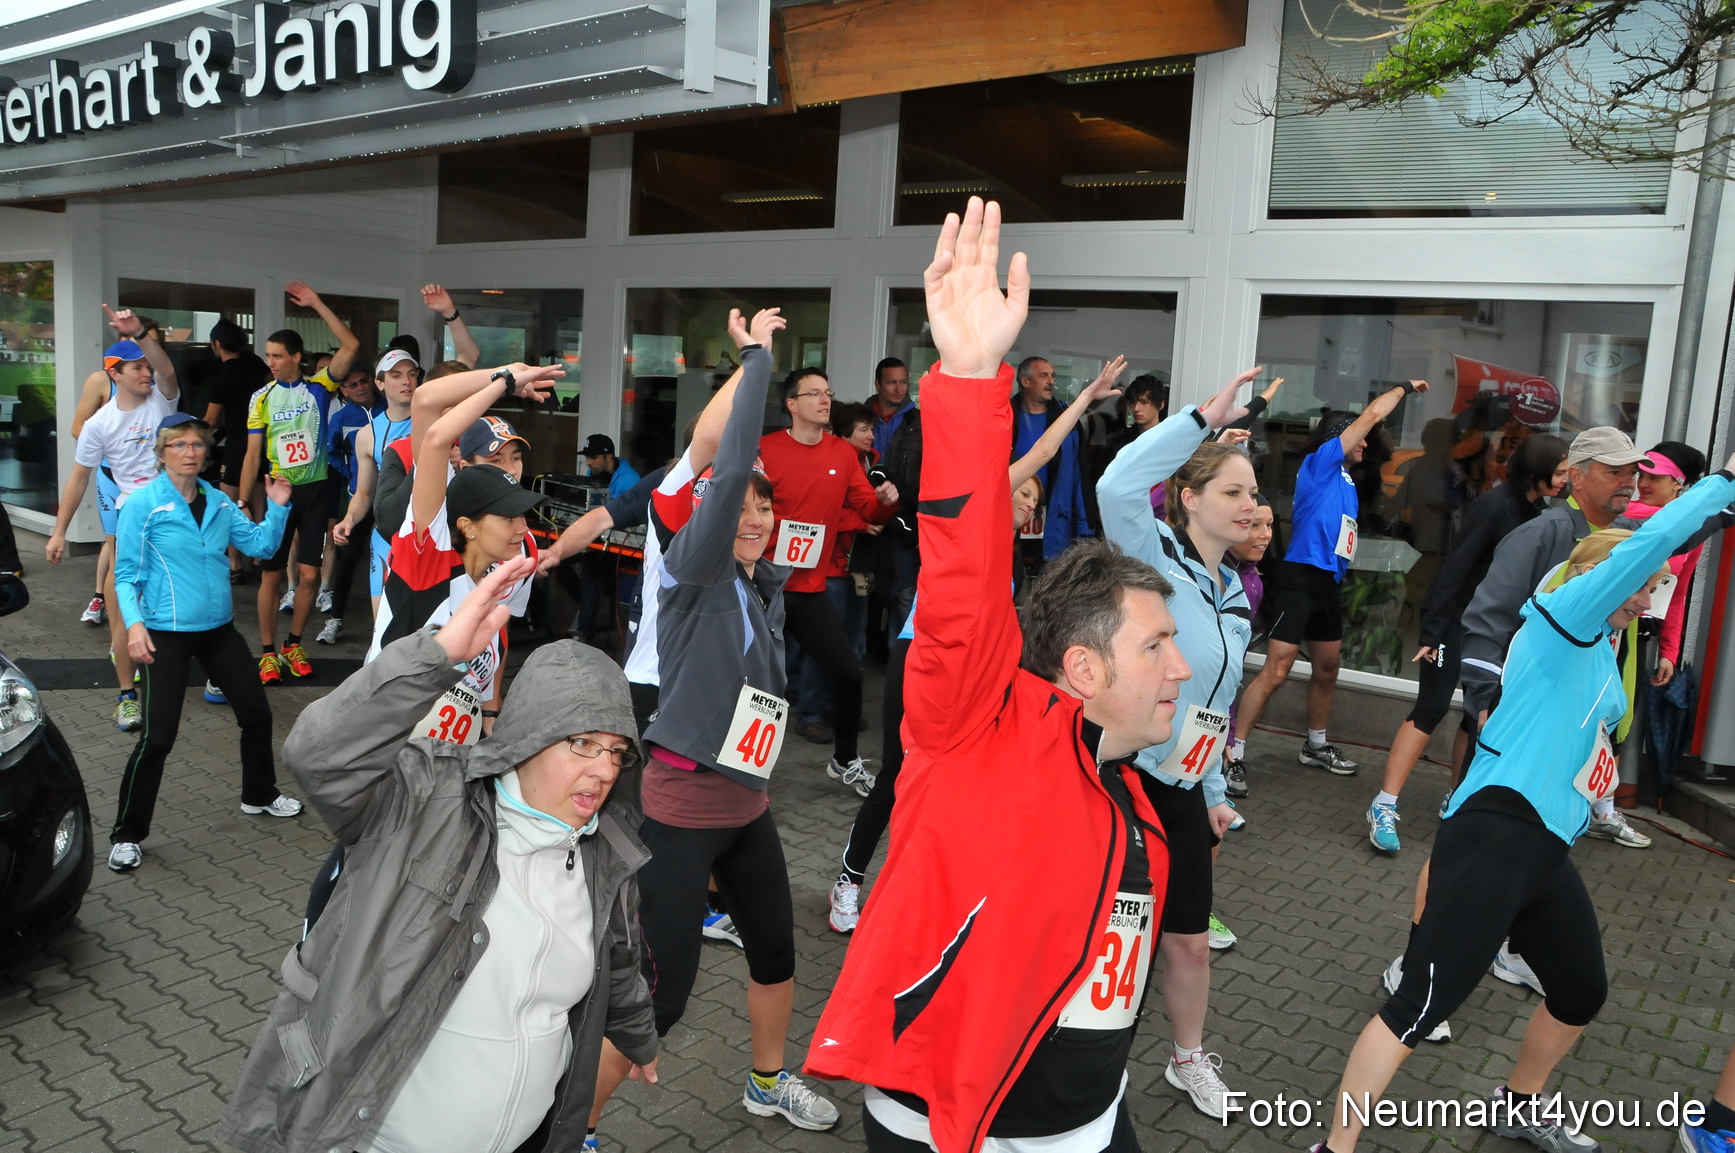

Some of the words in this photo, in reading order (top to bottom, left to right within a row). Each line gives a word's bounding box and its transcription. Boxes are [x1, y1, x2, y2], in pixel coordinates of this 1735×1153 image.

[183, 26, 222, 108] &
[285, 440, 309, 464] 23
[788, 523, 810, 531] MEYER
[786, 536, 814, 563] 67
[1346, 531, 1354, 555] 9
[468, 657, 488, 680] NIG
[444, 692, 471, 711] WERBUNG
[449, 686, 473, 705] MEYER
[750, 692, 778, 711] MEYER
[749, 702, 776, 718] WERBUNG
[1195, 711, 1222, 726] MEYER
[428, 704, 473, 746] 39
[1194, 719, 1220, 732] WERBUNG
[736, 717, 776, 768] 40
[1180, 733, 1217, 775] 41
[1587, 747, 1614, 799] 69
[1111, 898, 1140, 916] EYER
[1107, 914, 1139, 928] RBUNG
[1090, 931, 1142, 1011] 34
